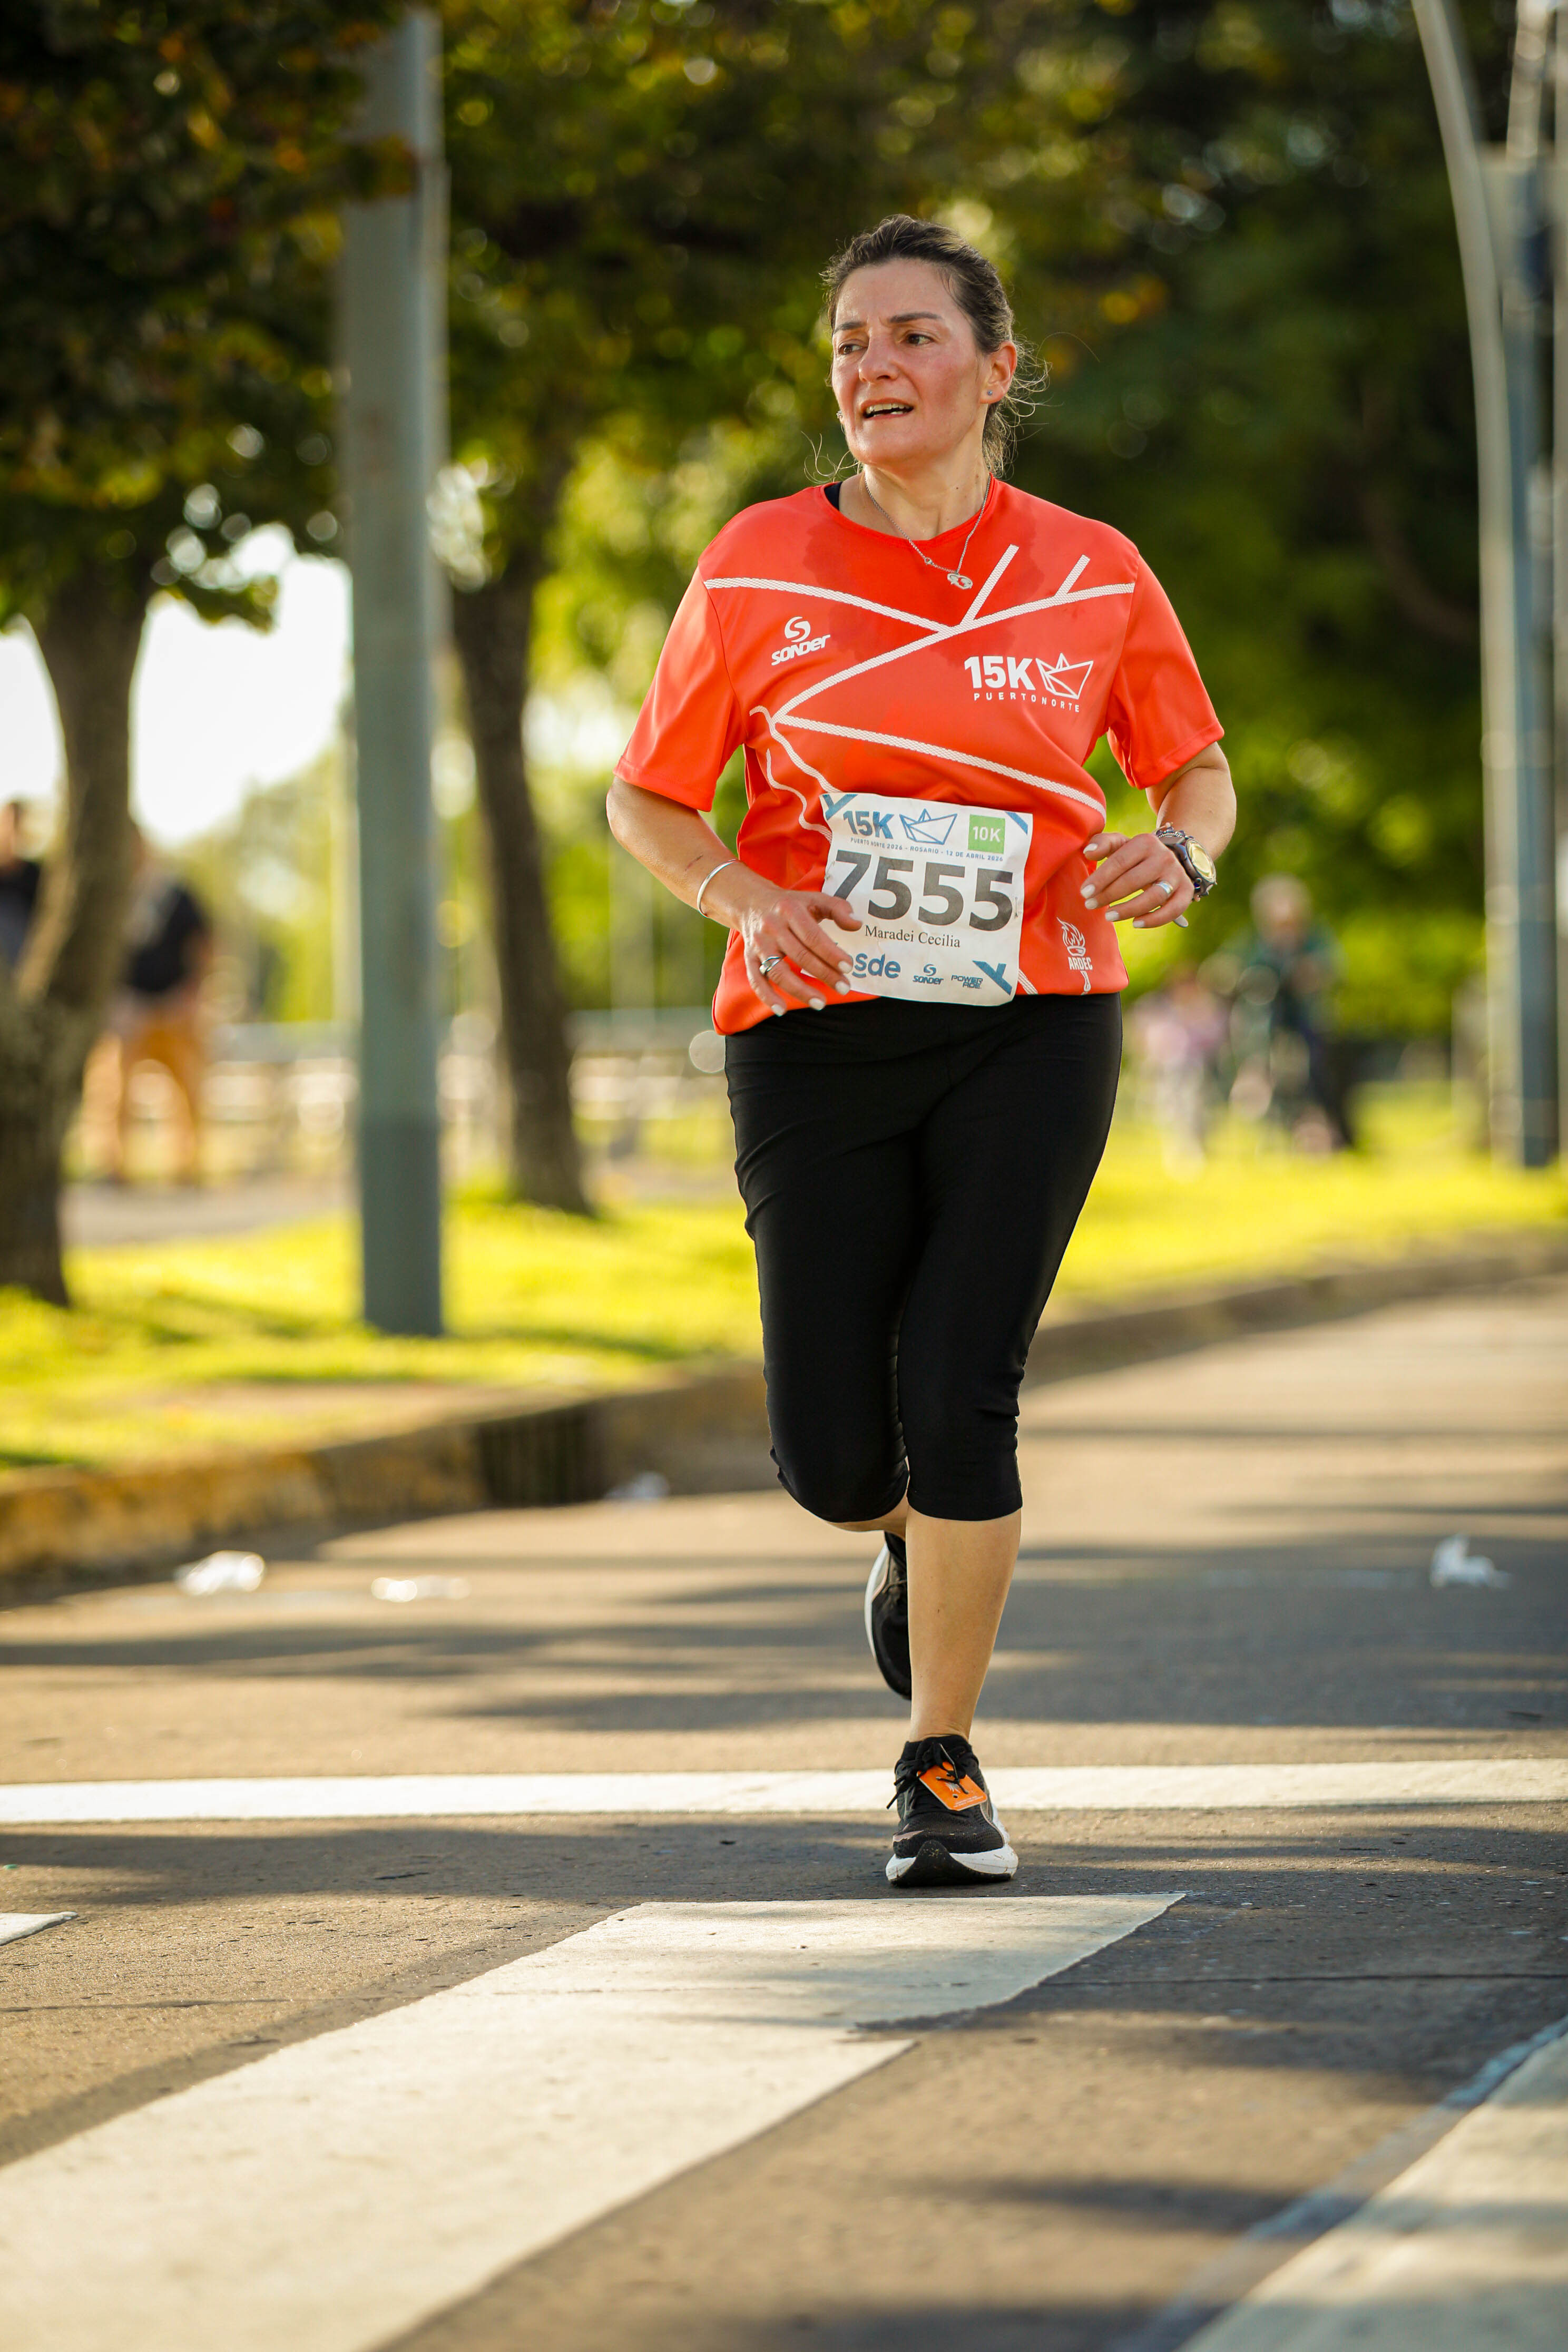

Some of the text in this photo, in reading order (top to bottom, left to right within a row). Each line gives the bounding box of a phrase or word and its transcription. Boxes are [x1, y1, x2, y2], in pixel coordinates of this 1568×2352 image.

[964, 655, 1036, 691] 15K
[843, 810, 895, 839] 15K
[972, 826, 1002, 843] 10K
[910, 846, 939, 854] ROSARIO
[833, 849, 1013, 932] 7555
[865, 925, 961, 948] Maradei Cecilia
[851, 953, 901, 978] sde
[1067, 956, 1093, 970] ARDEC
